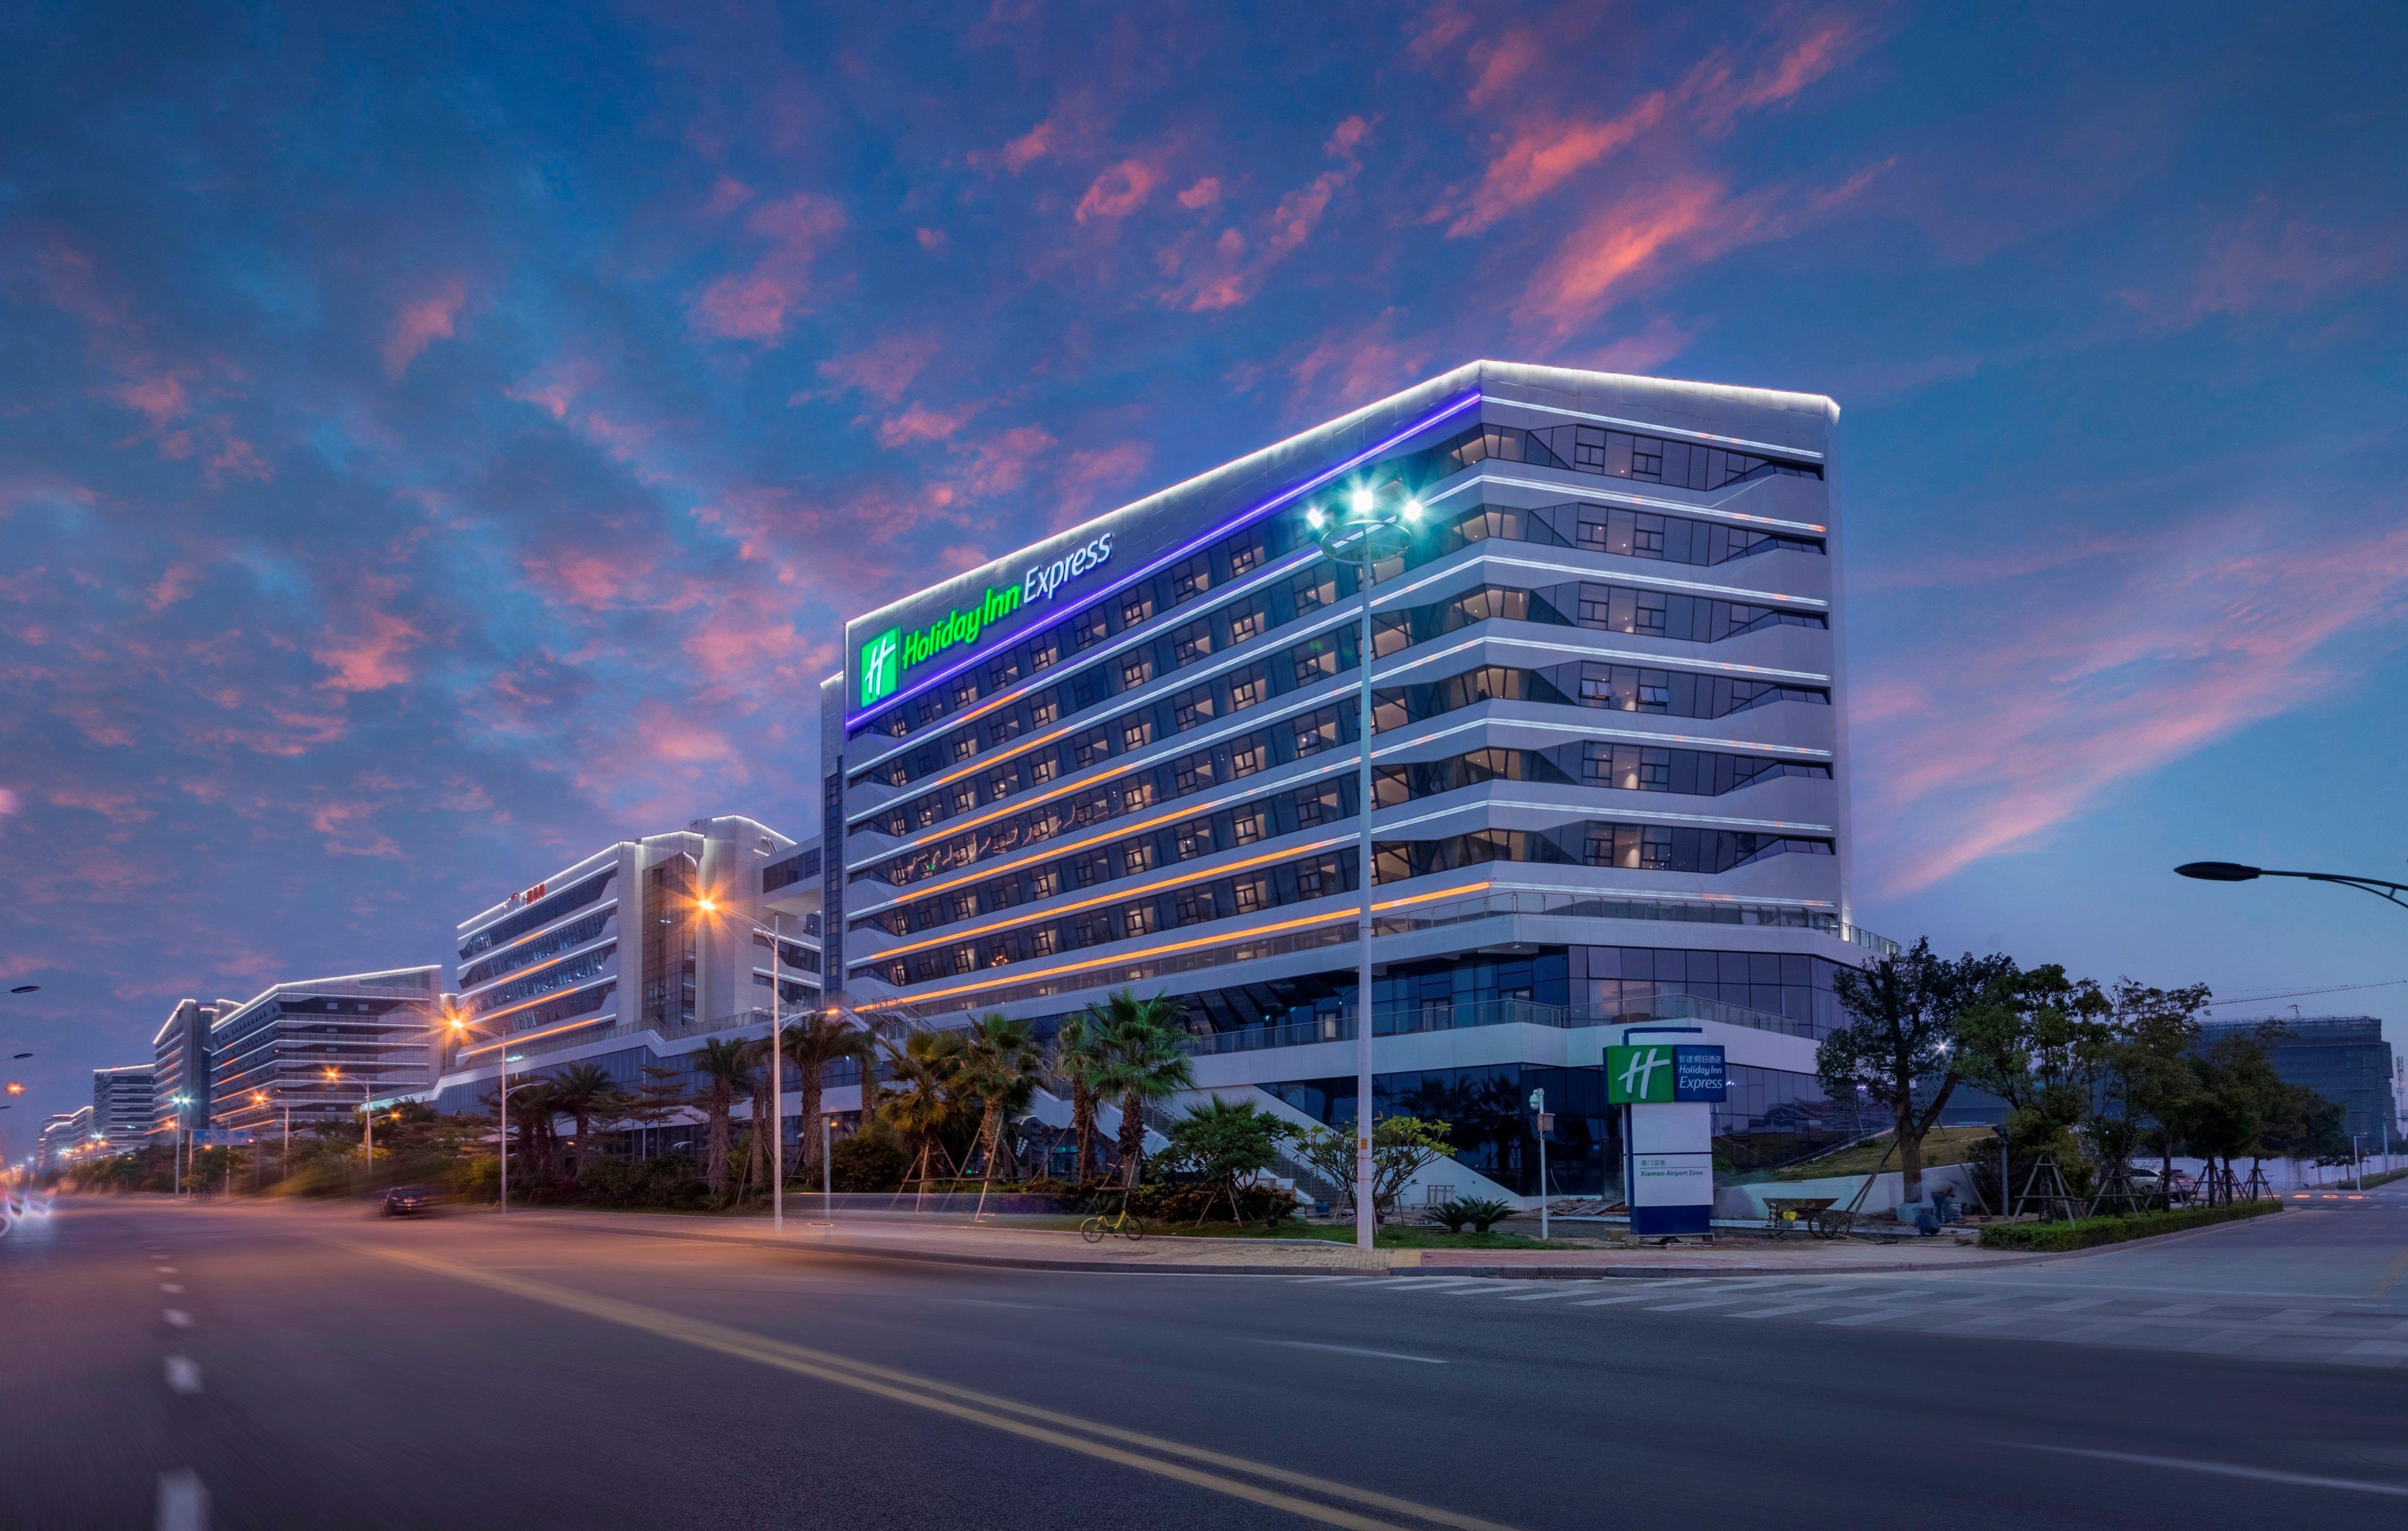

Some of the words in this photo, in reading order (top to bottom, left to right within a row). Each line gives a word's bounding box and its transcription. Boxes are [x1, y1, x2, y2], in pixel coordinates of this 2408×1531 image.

[902, 607, 981, 669] Holiday
[983, 586, 1020, 626] Inn
[1023, 532, 1111, 603] Express
[1678, 1055, 1722, 1063] 智选假日酒店
[1679, 1064, 1710, 1076] Holiday
[1710, 1064, 1722, 1074] Inn
[1679, 1076, 1723, 1092] Express
